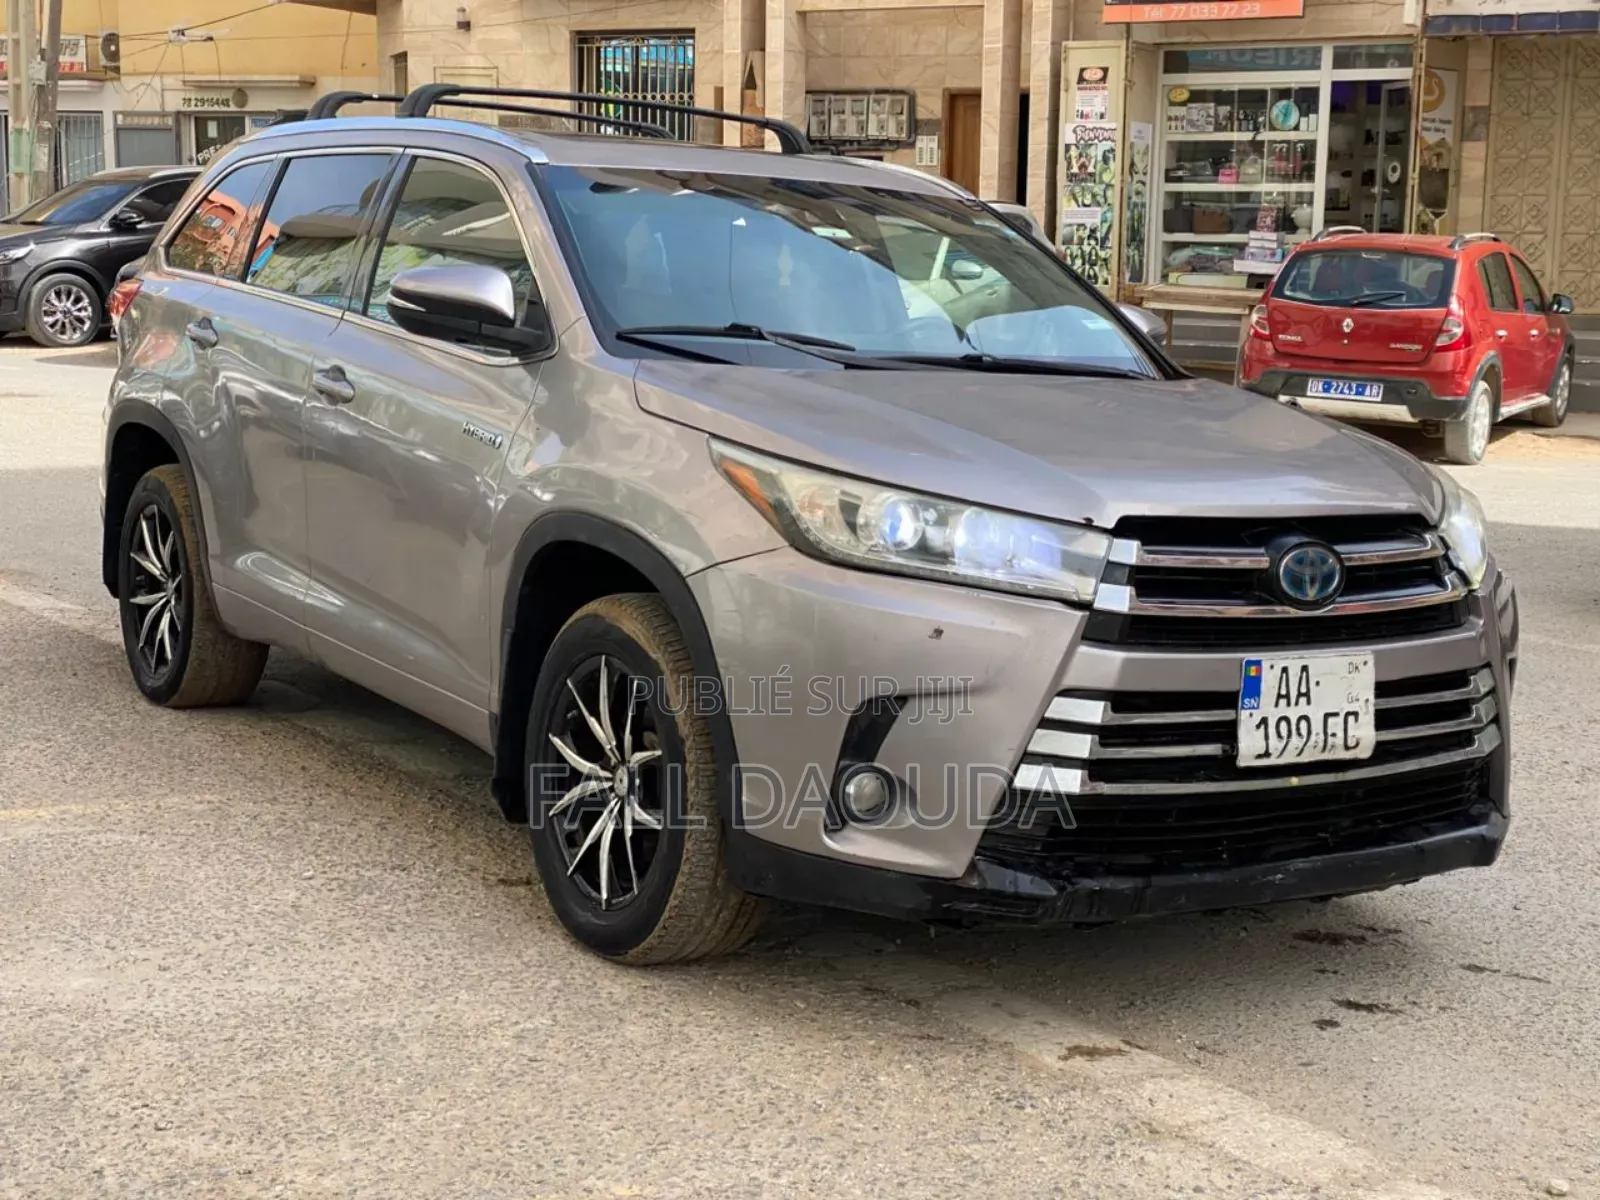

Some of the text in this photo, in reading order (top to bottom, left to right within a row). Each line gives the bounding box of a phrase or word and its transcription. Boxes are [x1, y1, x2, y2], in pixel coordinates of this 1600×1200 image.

[1170, 5, 1187, 19] 77
[1222, 3, 1239, 16] 77
[1242, 3, 1260, 15] 23
[1348, 662, 1361, 675] DK
[1243, 697, 1259, 709] SN
